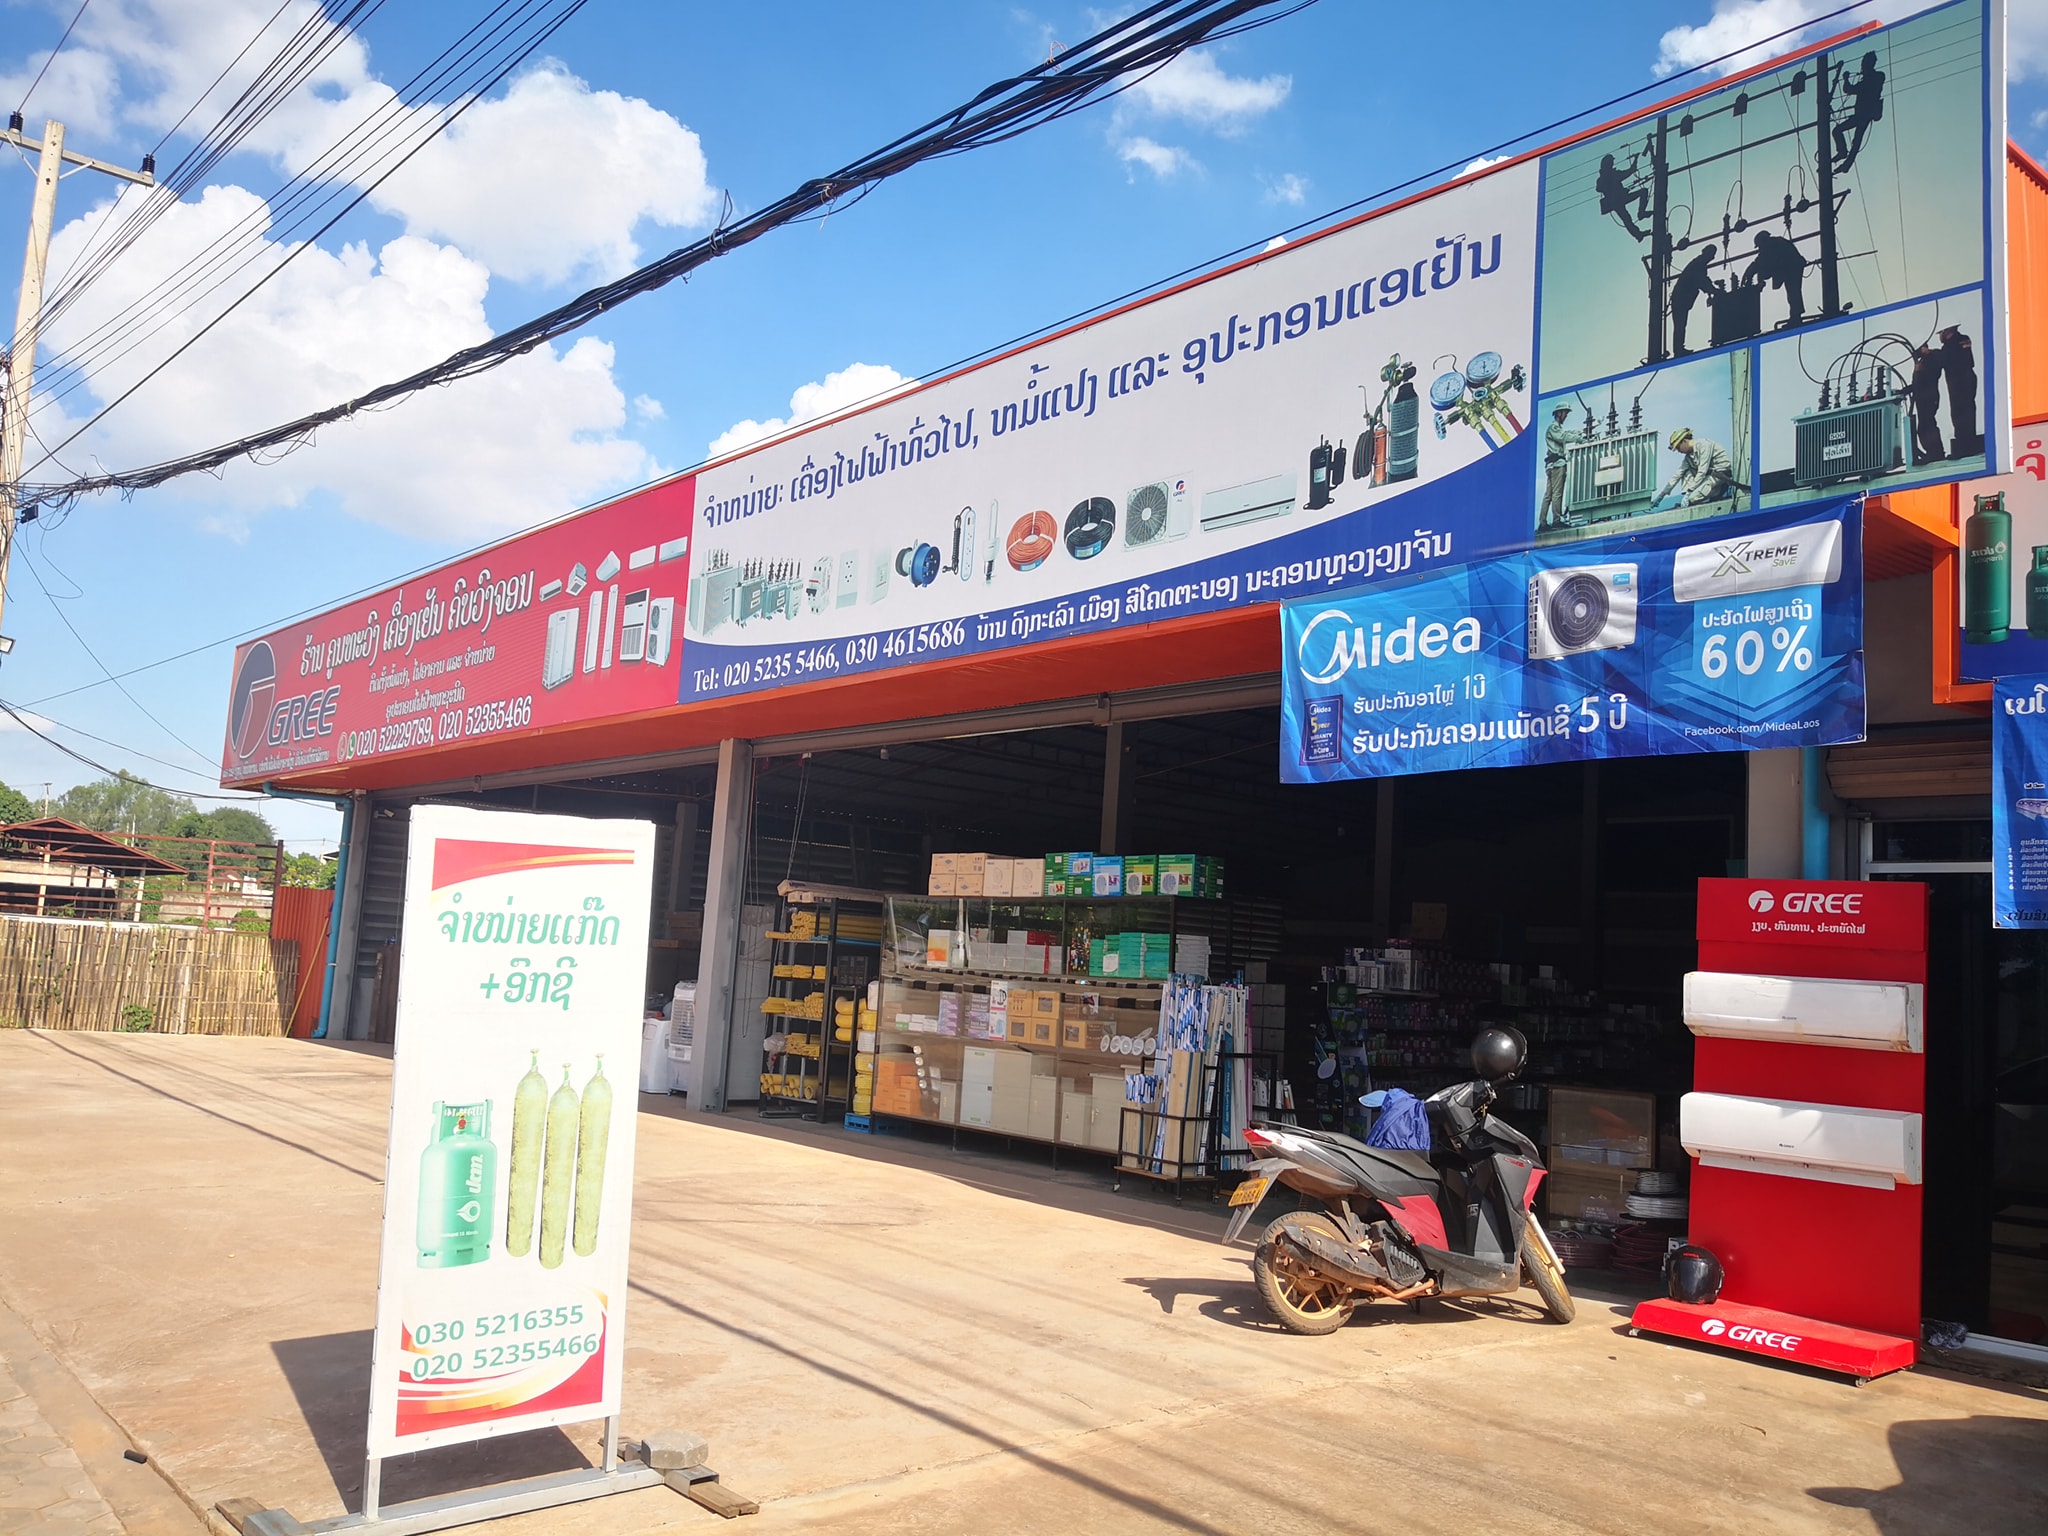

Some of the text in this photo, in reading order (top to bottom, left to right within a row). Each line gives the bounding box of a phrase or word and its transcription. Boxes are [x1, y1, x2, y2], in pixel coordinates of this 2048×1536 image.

[1108, 352, 1170, 398] ແລະ
[1182, 233, 1502, 384] ອຸປະກອນແອເຢັນ
[300, 634, 324, 677] ຮ້ານ
[383, 588, 444, 656] ເຄື່ອງເຢັນ
[448, 568, 535, 633] ຄົບວົງຈອນ
[977, 613, 1007, 642] ບ້ານ
[1080, 594, 1120, 623] ເມືອງ
[694, 618, 966, 692] Tel: 020 5235 5466, 030 4615686
[1299, 609, 1481, 684] Midea
[1701, 625, 1814, 679] 60%
[267, 684, 341, 746] GREE
[356, 695, 532, 756] 020 52229789, 020 52355466
[1578, 696, 1600, 733] 5
[1609, 693, 1628, 730] ປີ
[1684, 719, 1820, 737] Facebook.com/MideaLaos
[1782, 892, 1864, 914] GREE
[415, 1304, 584, 1345] 030 5216355
[1728, 1325, 1802, 1351] GREE
[413, 1333, 597, 1379] 020 52355466
